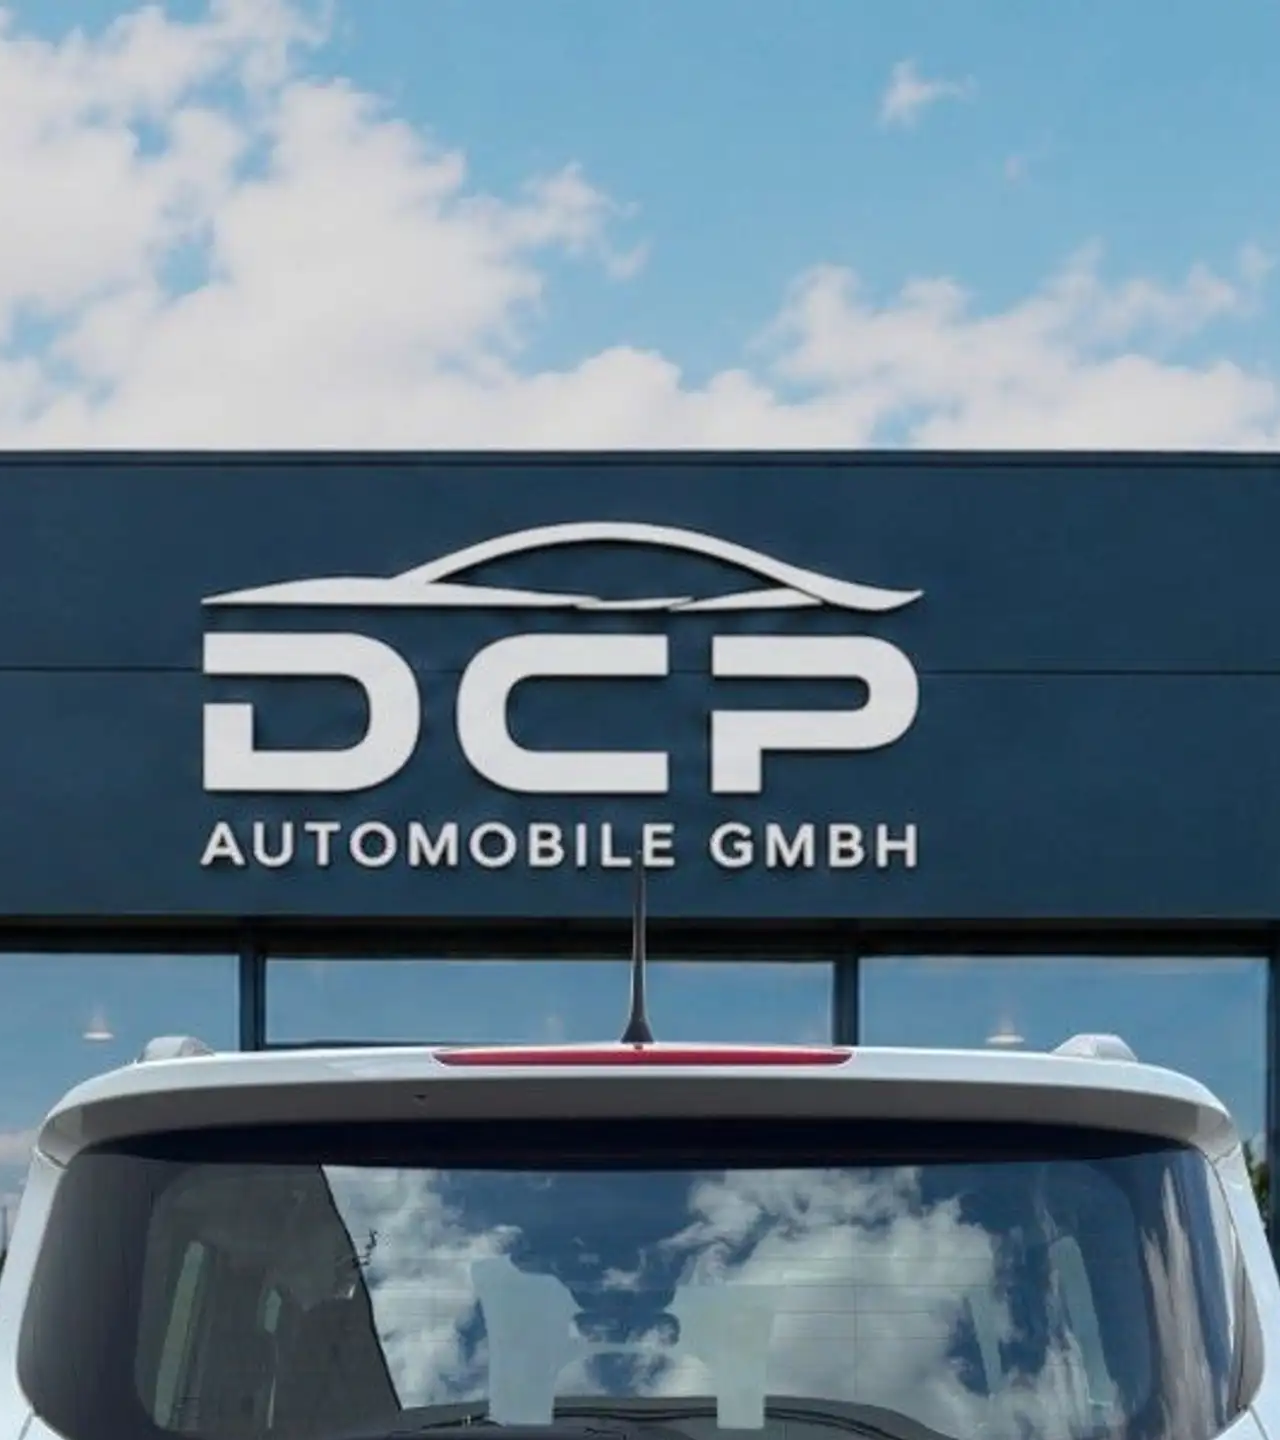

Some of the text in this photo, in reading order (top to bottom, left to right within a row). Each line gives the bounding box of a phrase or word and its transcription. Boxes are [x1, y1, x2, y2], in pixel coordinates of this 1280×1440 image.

[203, 632, 919, 793] DCP
[201, 822, 917, 868] AUTOMOBILE GMBH
